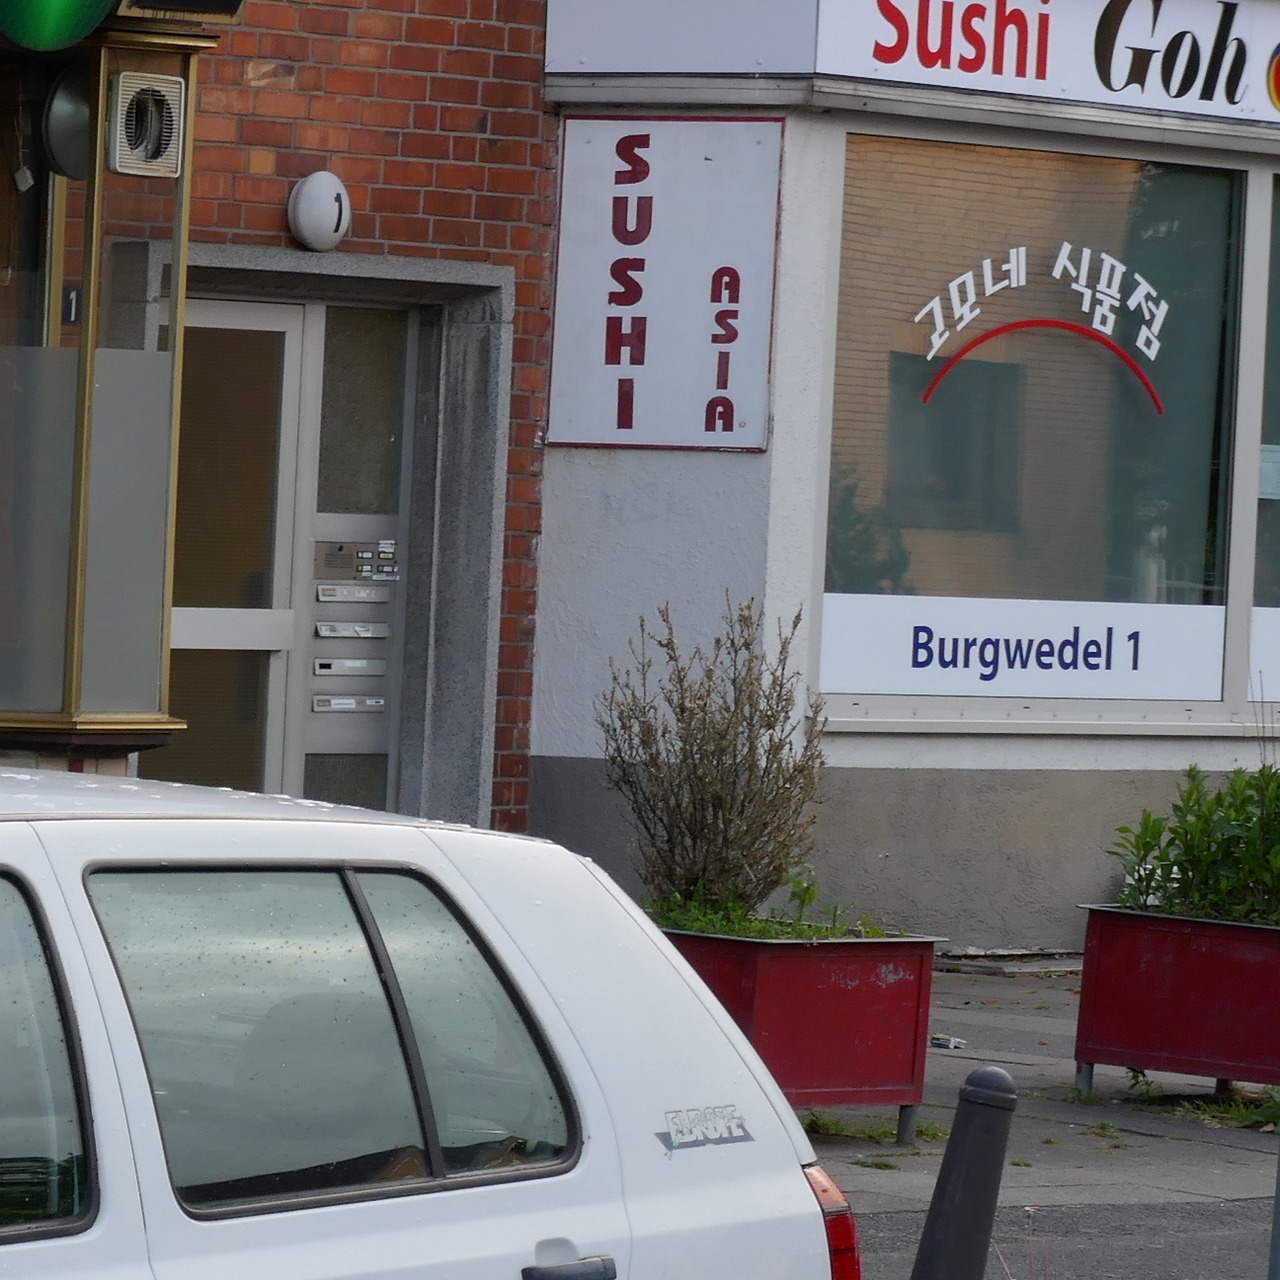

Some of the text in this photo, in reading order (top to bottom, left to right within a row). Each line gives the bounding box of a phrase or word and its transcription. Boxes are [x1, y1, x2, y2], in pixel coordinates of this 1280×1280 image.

[872, 0, 1248, 105] Sushi Goh
[333, 192, 343, 233] 1
[69, 290, 77, 322] 1
[605, 133, 653, 430] SUSHI
[914, 241, 1169, 361] 고모네 식품점
[705, 266, 740, 432] ASIA
[912, 625, 1141, 681] Burgwedel 1
